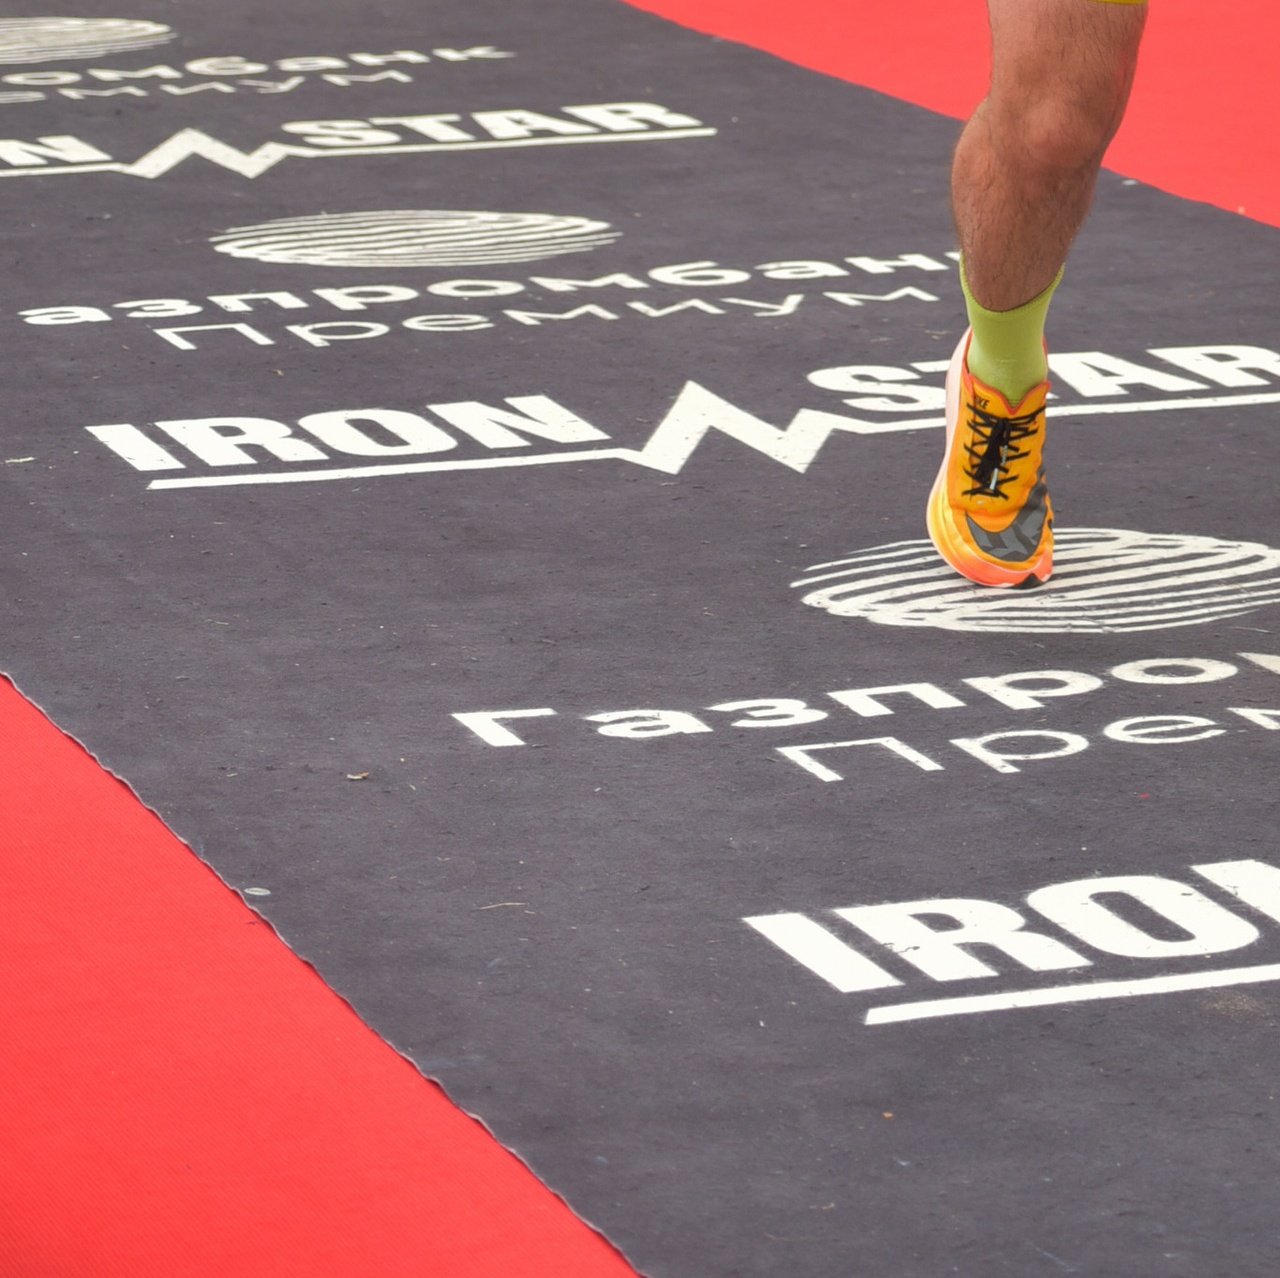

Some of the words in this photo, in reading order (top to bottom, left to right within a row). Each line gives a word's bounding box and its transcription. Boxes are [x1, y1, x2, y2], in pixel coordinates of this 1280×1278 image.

[281, 102, 703, 145] STAR
[18, 251, 962, 325] азпромбан
[85, 395, 611, 471] IRON
